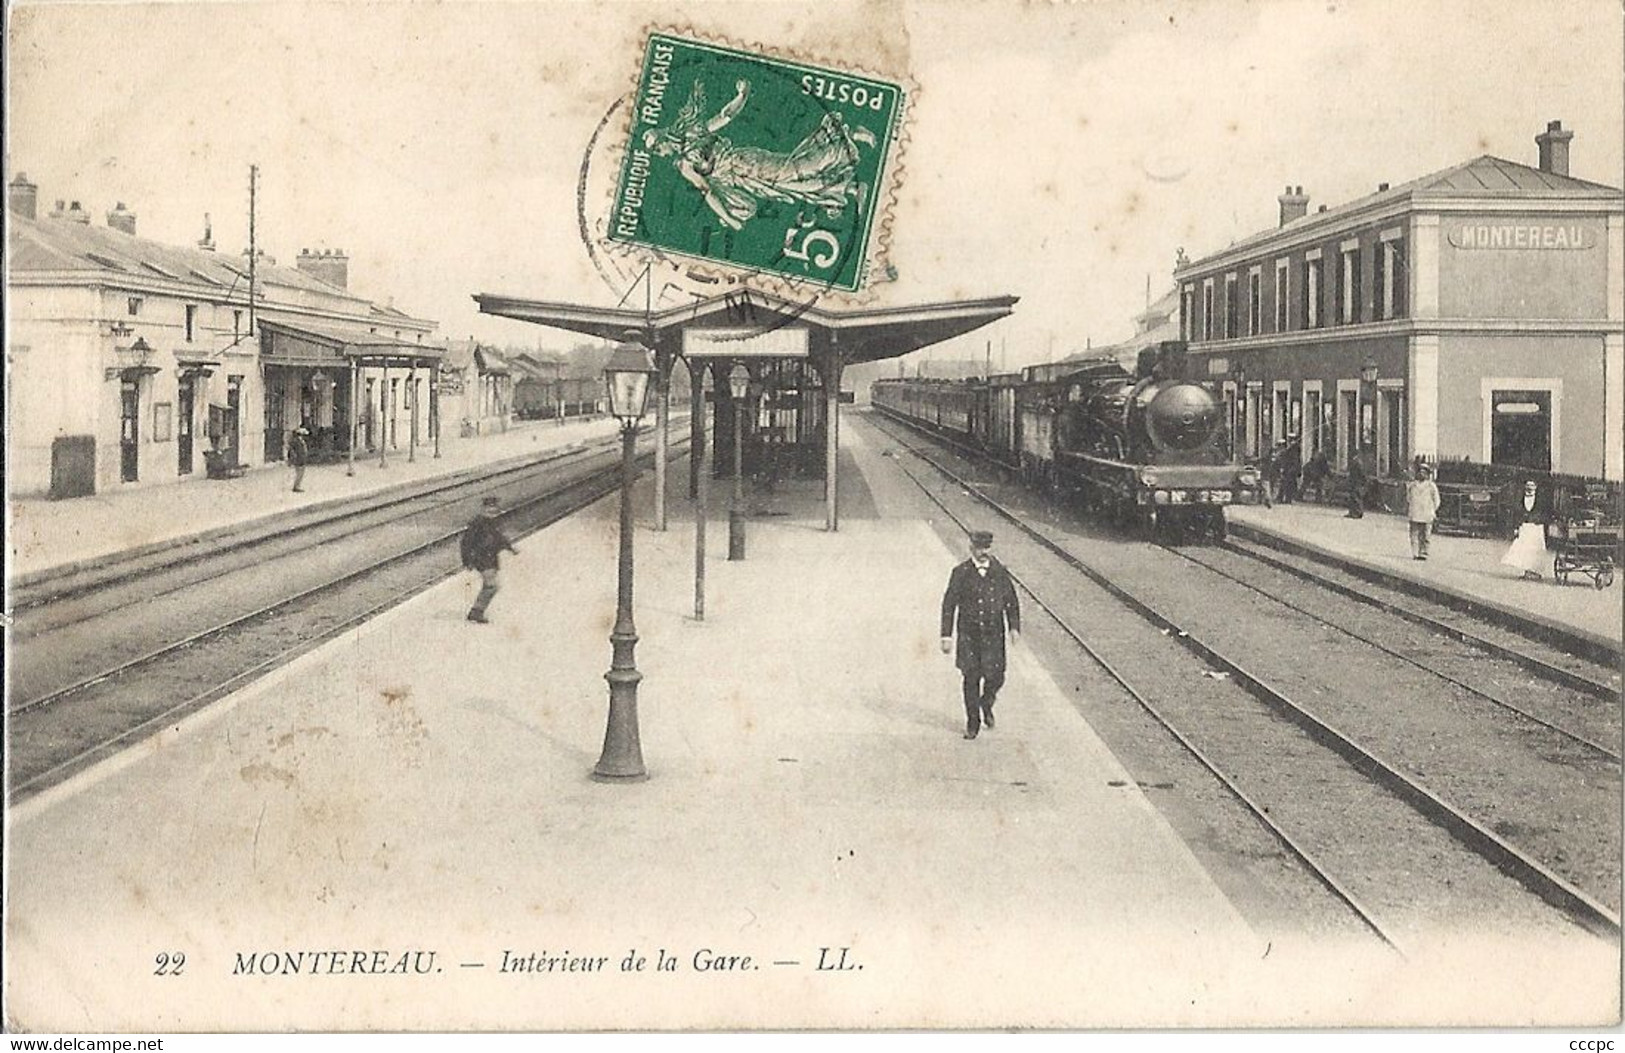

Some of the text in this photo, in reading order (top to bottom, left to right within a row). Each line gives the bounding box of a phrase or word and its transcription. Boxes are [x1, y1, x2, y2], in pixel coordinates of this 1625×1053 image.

[801, 75, 884, 111] POSTES
[1461, 225, 1583, 248] MONTEREAU
[153, 952, 186, 976] 22
[232, 951, 443, 975] MONTEREAU.
[499, 949, 609, 973] Intérieur
[620, 948, 647, 973] de
[656, 948, 678, 973] la
[692, 948, 760, 972] Gare.
[815, 947, 864, 972] LL.
